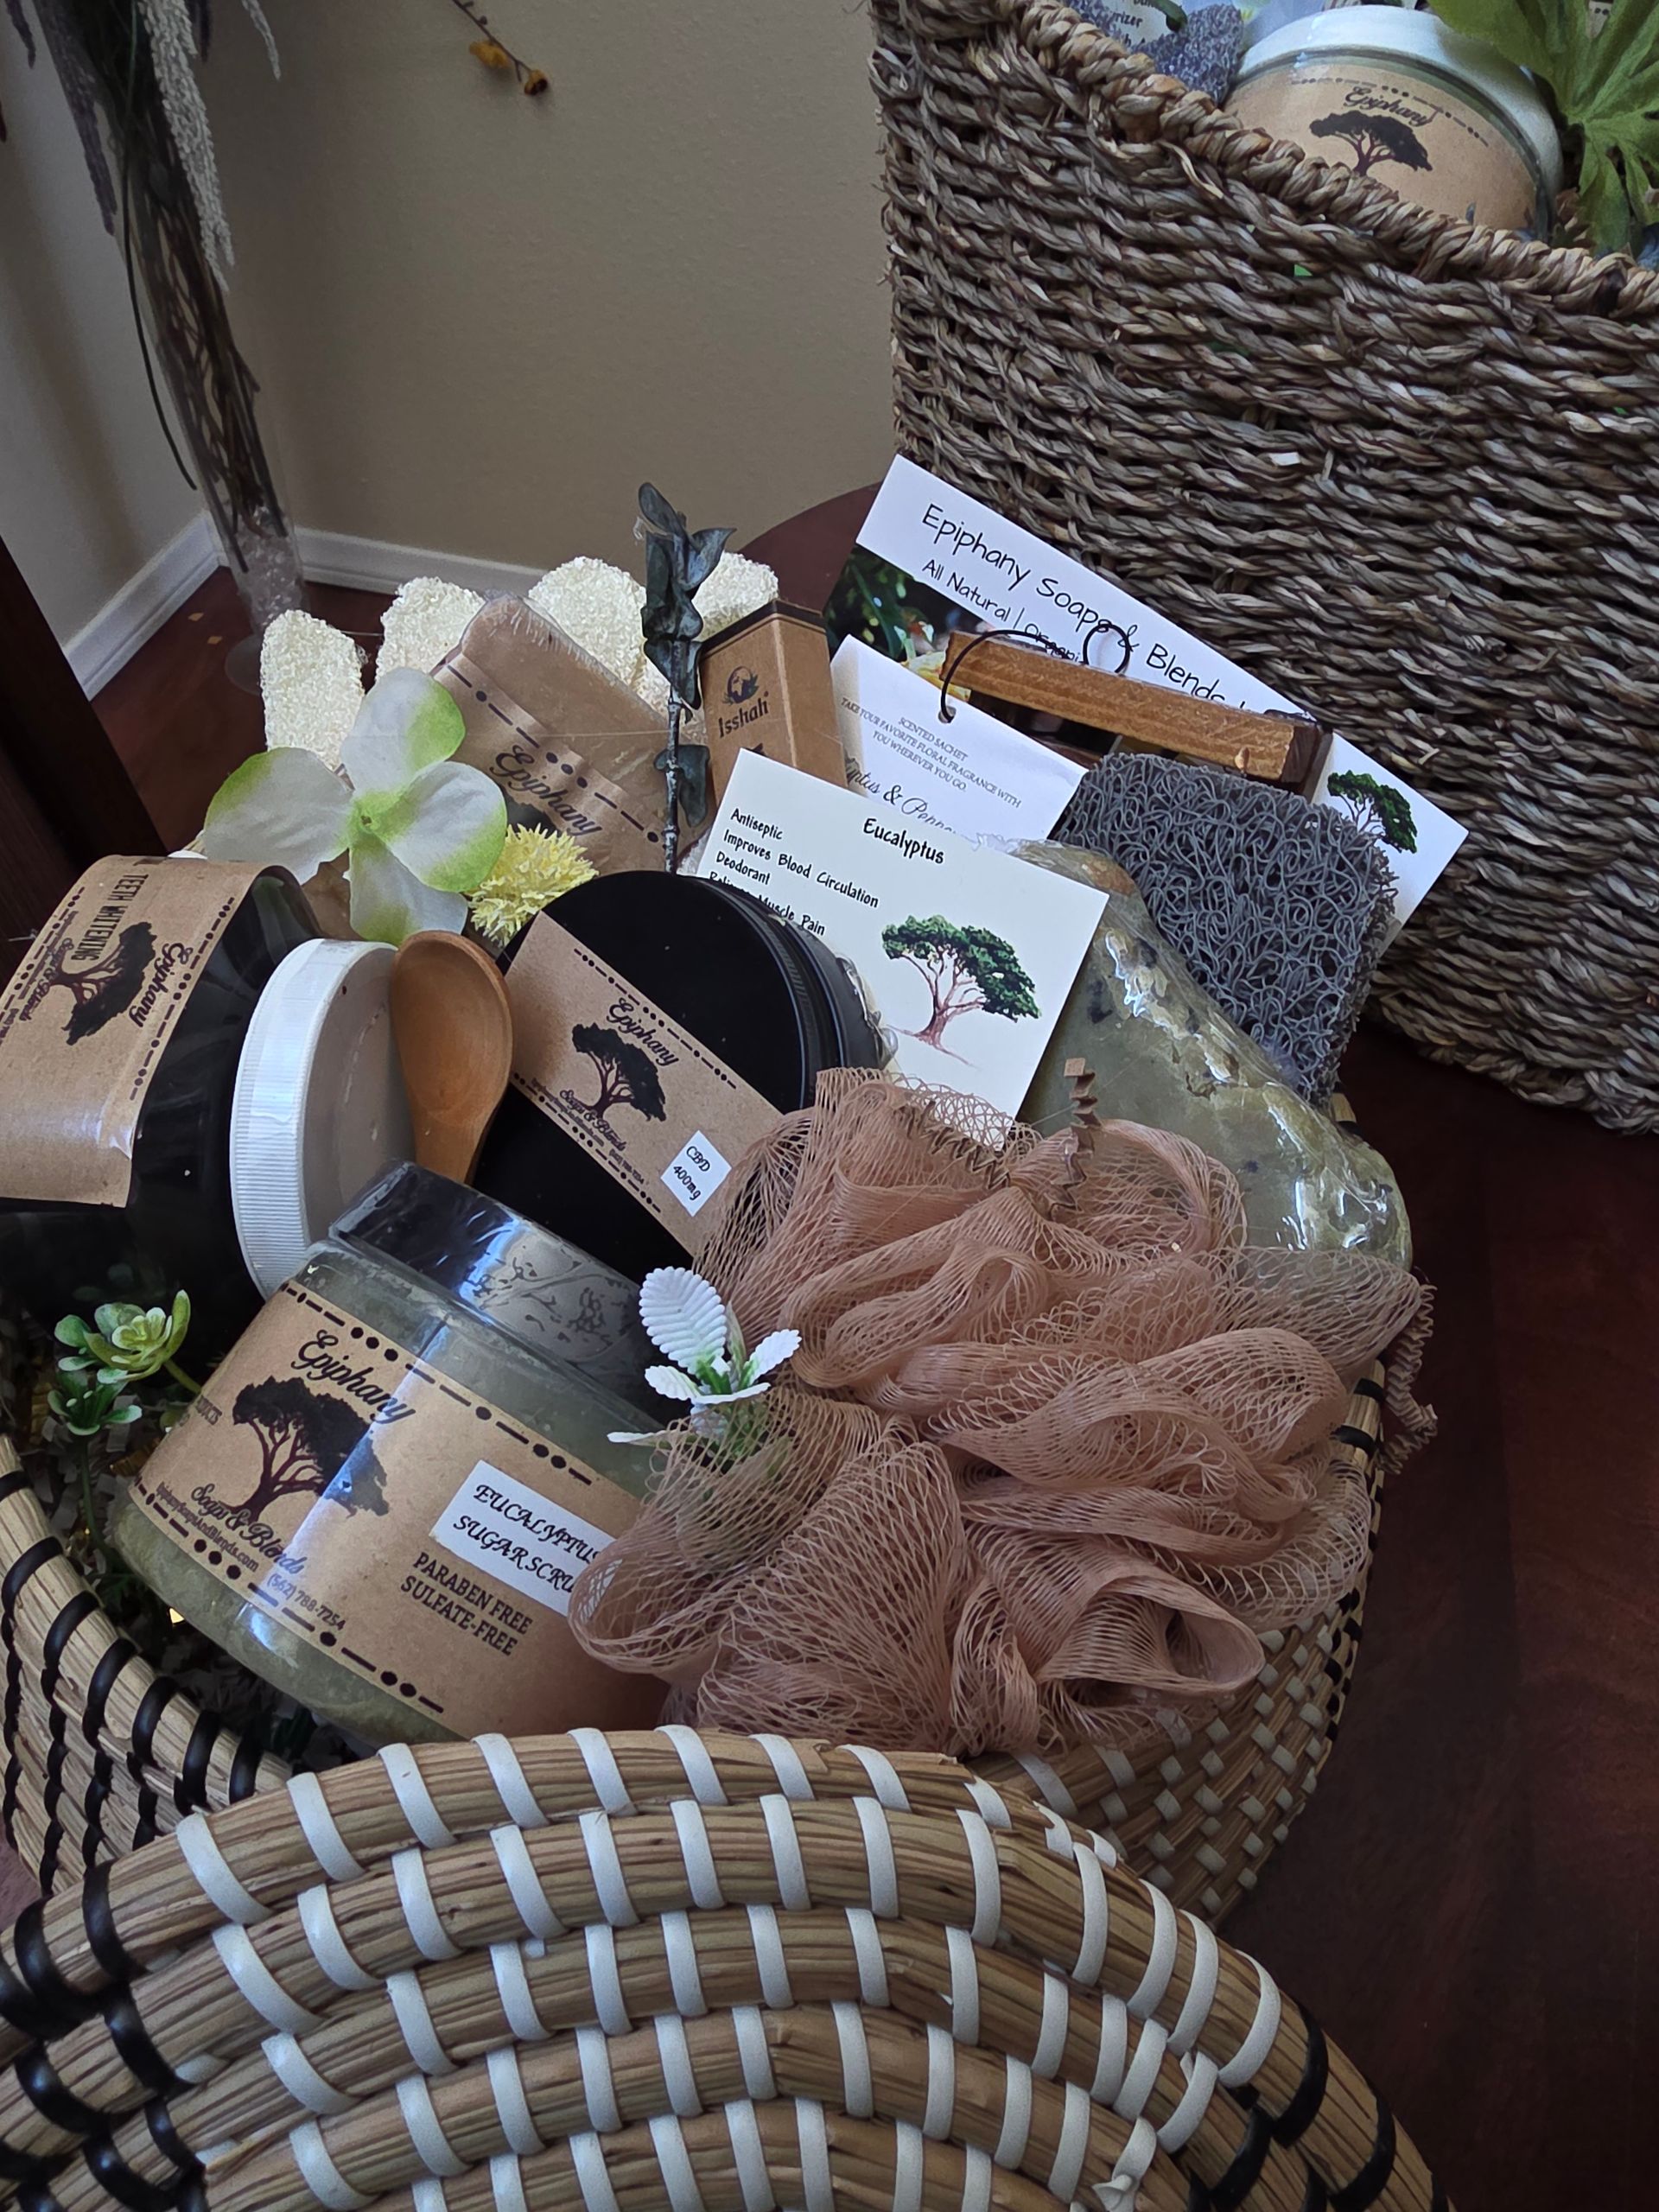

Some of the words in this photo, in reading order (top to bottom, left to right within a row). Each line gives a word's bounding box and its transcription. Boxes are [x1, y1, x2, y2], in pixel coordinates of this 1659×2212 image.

[1344, 86, 1435, 127] Epiphany
[922, 503, 1032, 591] Epiphany
[1037, 576, 1112, 633] Soaps
[1117, 624, 1140, 652] &
[922, 559, 943, 582] All
[947, 574, 1012, 622] Natural
[841, 697, 860, 714] TAKE
[861, 709, 880, 725] YOUR
[880, 719, 919, 747] FAVORITE
[916, 737, 948, 766] FLORAL
[948, 760, 998, 794] FRAGRANCE
[995, 786, 1021, 808] WITH
[873, 730, 891, 746] YOU
[889, 740, 934, 772] WHEREVER
[933, 766, 953, 783] YOU
[898, 717, 935, 743] SCENTED
[934, 736, 969, 761] SACHET
[489, 744, 602, 836] Epiphany
[883, 785, 903, 805] &
[731, 808, 783, 840] Antiseptic
[862, 817, 945, 865] Eucalyptus
[107, 874, 149, 901] TEETH
[716, 851, 771, 885] Deodorant
[724, 830, 771, 860] Improves
[778, 854, 812, 878] Blood
[817, 872, 879, 908] Circulation
[71, 905, 129, 961] WHITENING
[801, 914, 825, 936] Pain
[130, 943, 194, 1027] Epiphany
[607, 997, 679, 1066] Epiphany
[672, 1165, 702, 1201] 400mg
[685, 1146, 711, 1173] CBD
[291, 1329, 416, 1424] Epiphany
[191, 1484, 230, 1520] Soaps
[226, 1509, 251, 1530] &
[239, 1522, 308, 1574] Blends
[453, 1515, 529, 1570] SUGAR
[524, 1556, 575, 1593] SCRU
[267, 1573, 297, 1599] (562)
[298, 1590, 346, 1630] 788-7254
[401, 1576, 518, 1656] SULFATE-FREE
[413, 1552, 490, 1610] PARABEN
[488, 1599, 533, 1636] FREE
